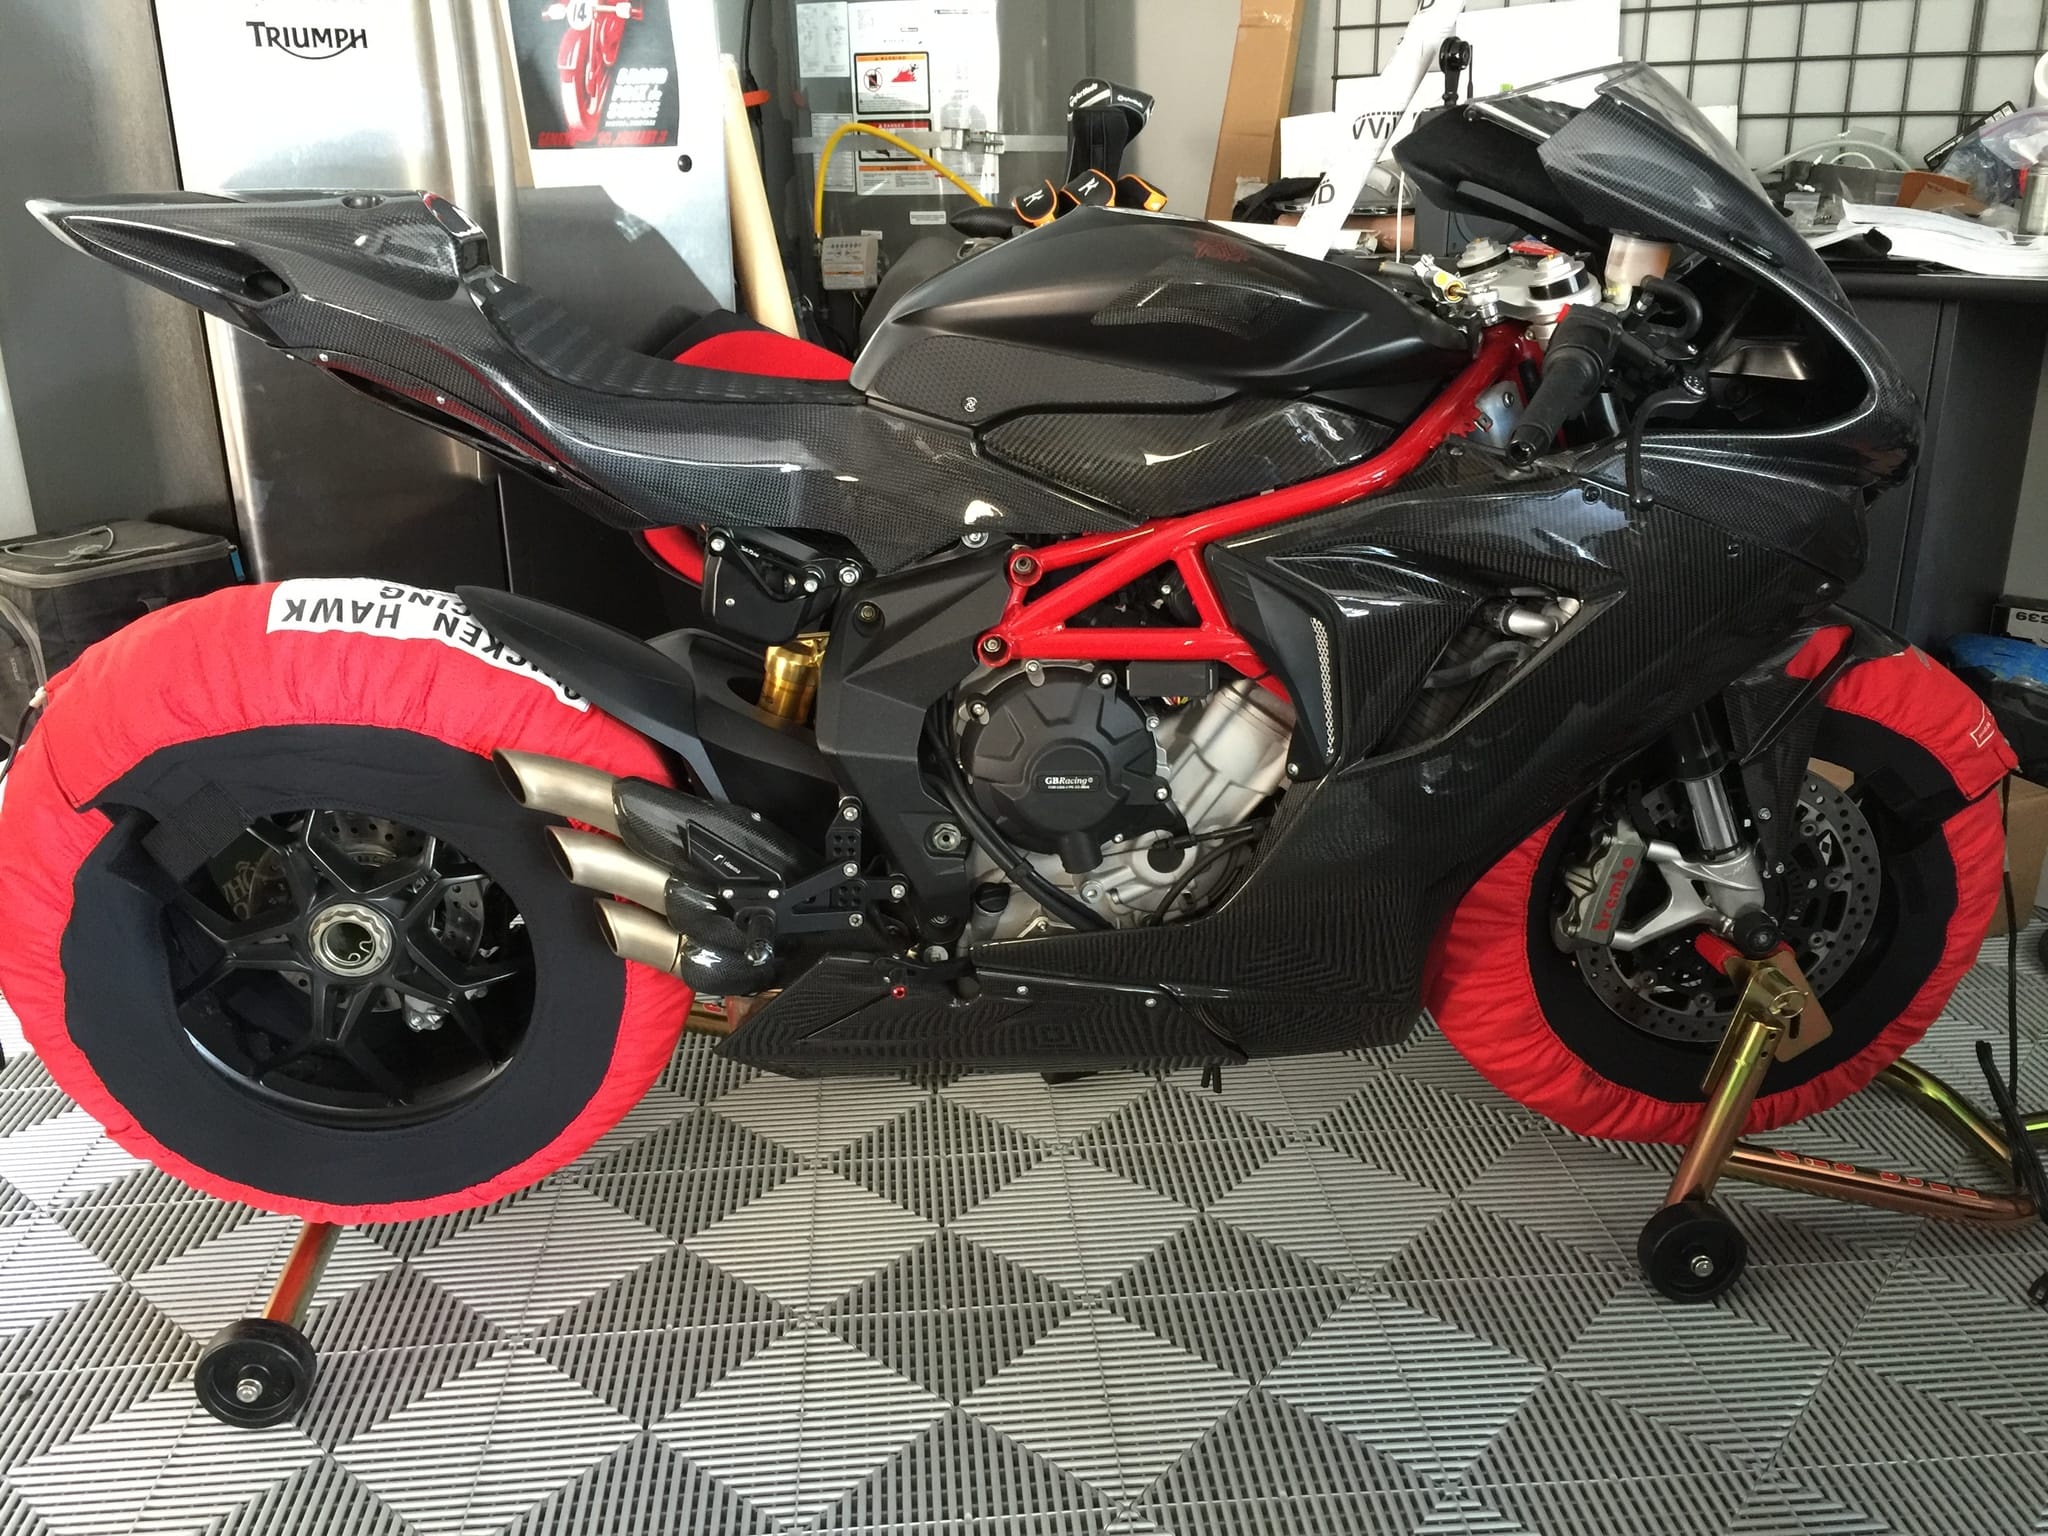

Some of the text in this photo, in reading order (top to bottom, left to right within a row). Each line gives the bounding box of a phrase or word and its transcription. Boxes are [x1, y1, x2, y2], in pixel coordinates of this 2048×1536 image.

[245, 21, 368, 59] TRIUMPH
[281, 597, 402, 630] HAWK
[379, 585, 471, 616] CING
[1592, 856, 1634, 931] brembo
